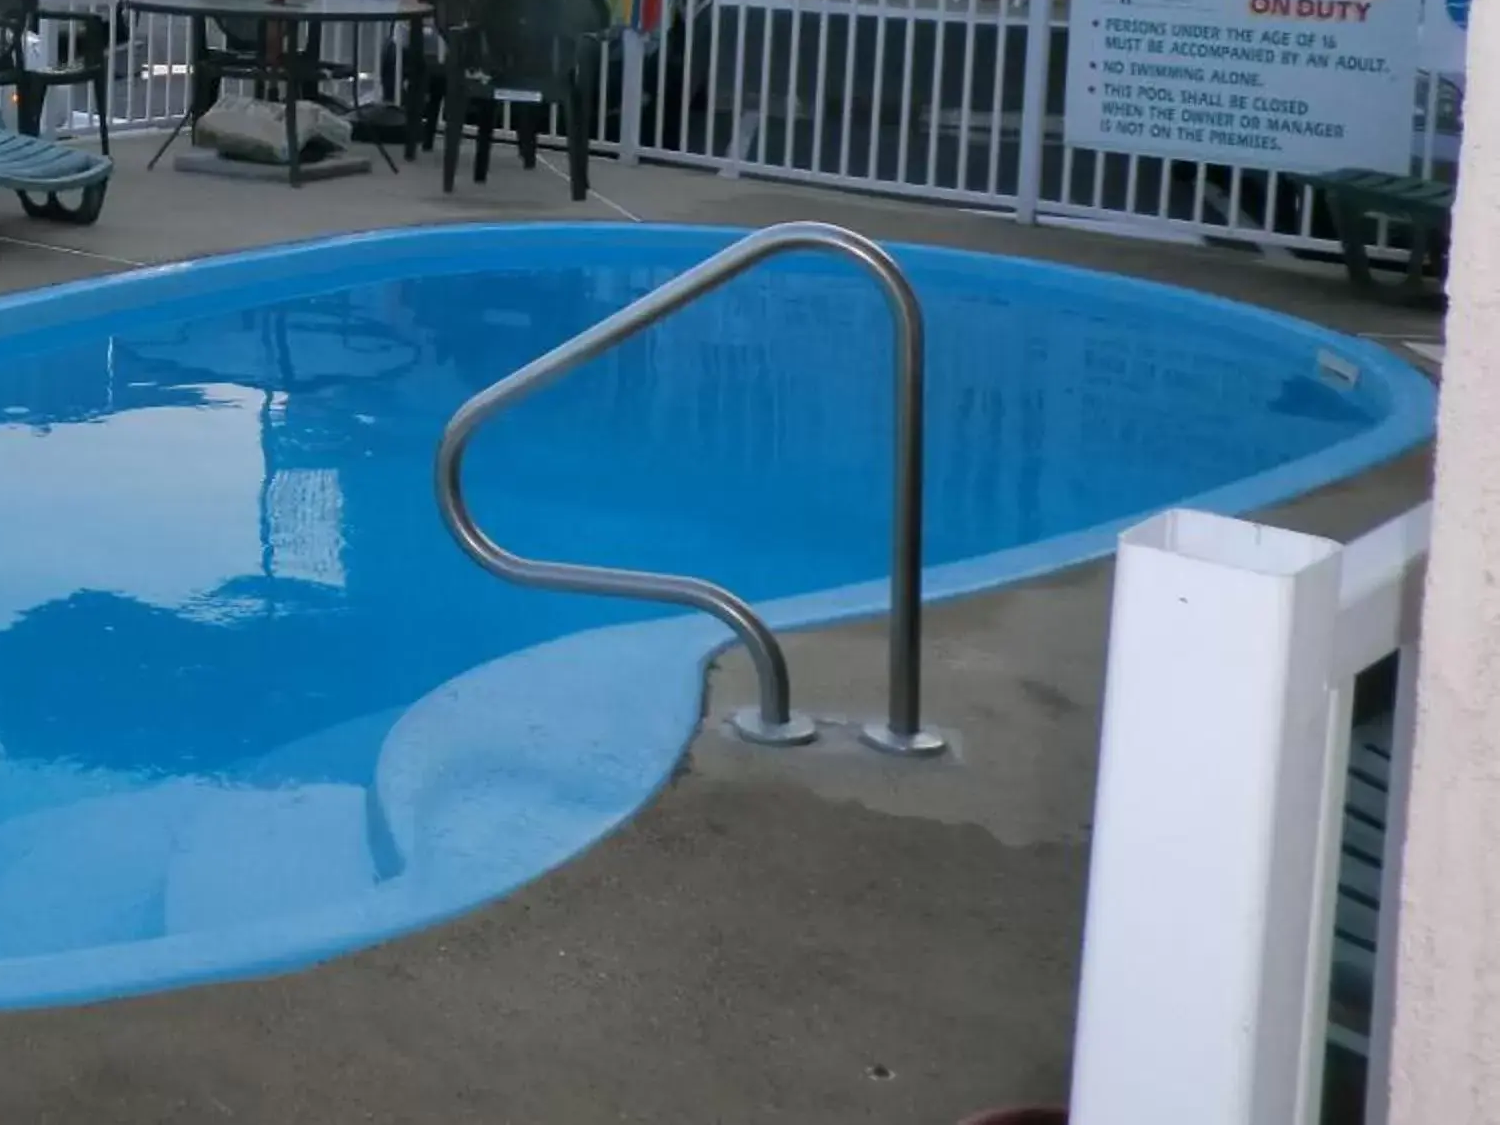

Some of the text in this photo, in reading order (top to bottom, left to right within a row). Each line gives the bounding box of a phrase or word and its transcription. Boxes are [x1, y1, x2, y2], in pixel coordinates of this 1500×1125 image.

[1105, 18, 1166, 36] PERSONS
[1172, 24, 1220, 40] UNDER
[1227, 28, 1253, 43] THE
[1260, 30, 1292, 46] AGE
[1296, 33, 1316, 47] OF
[1104, 36, 1391, 73] MUST BE ACCOMPANIED BY AN ADULT.
[1103, 60, 1264, 88] NO SWIMMING ALONE.
[1104, 83, 1309, 115] THIS POOL SHALL BE CLOSED
[1100, 119, 1283, 151] IS NOT ON THE PREMISES.
[1102, 101, 1345, 138] WHEN THE OWNER OR MANAGER
